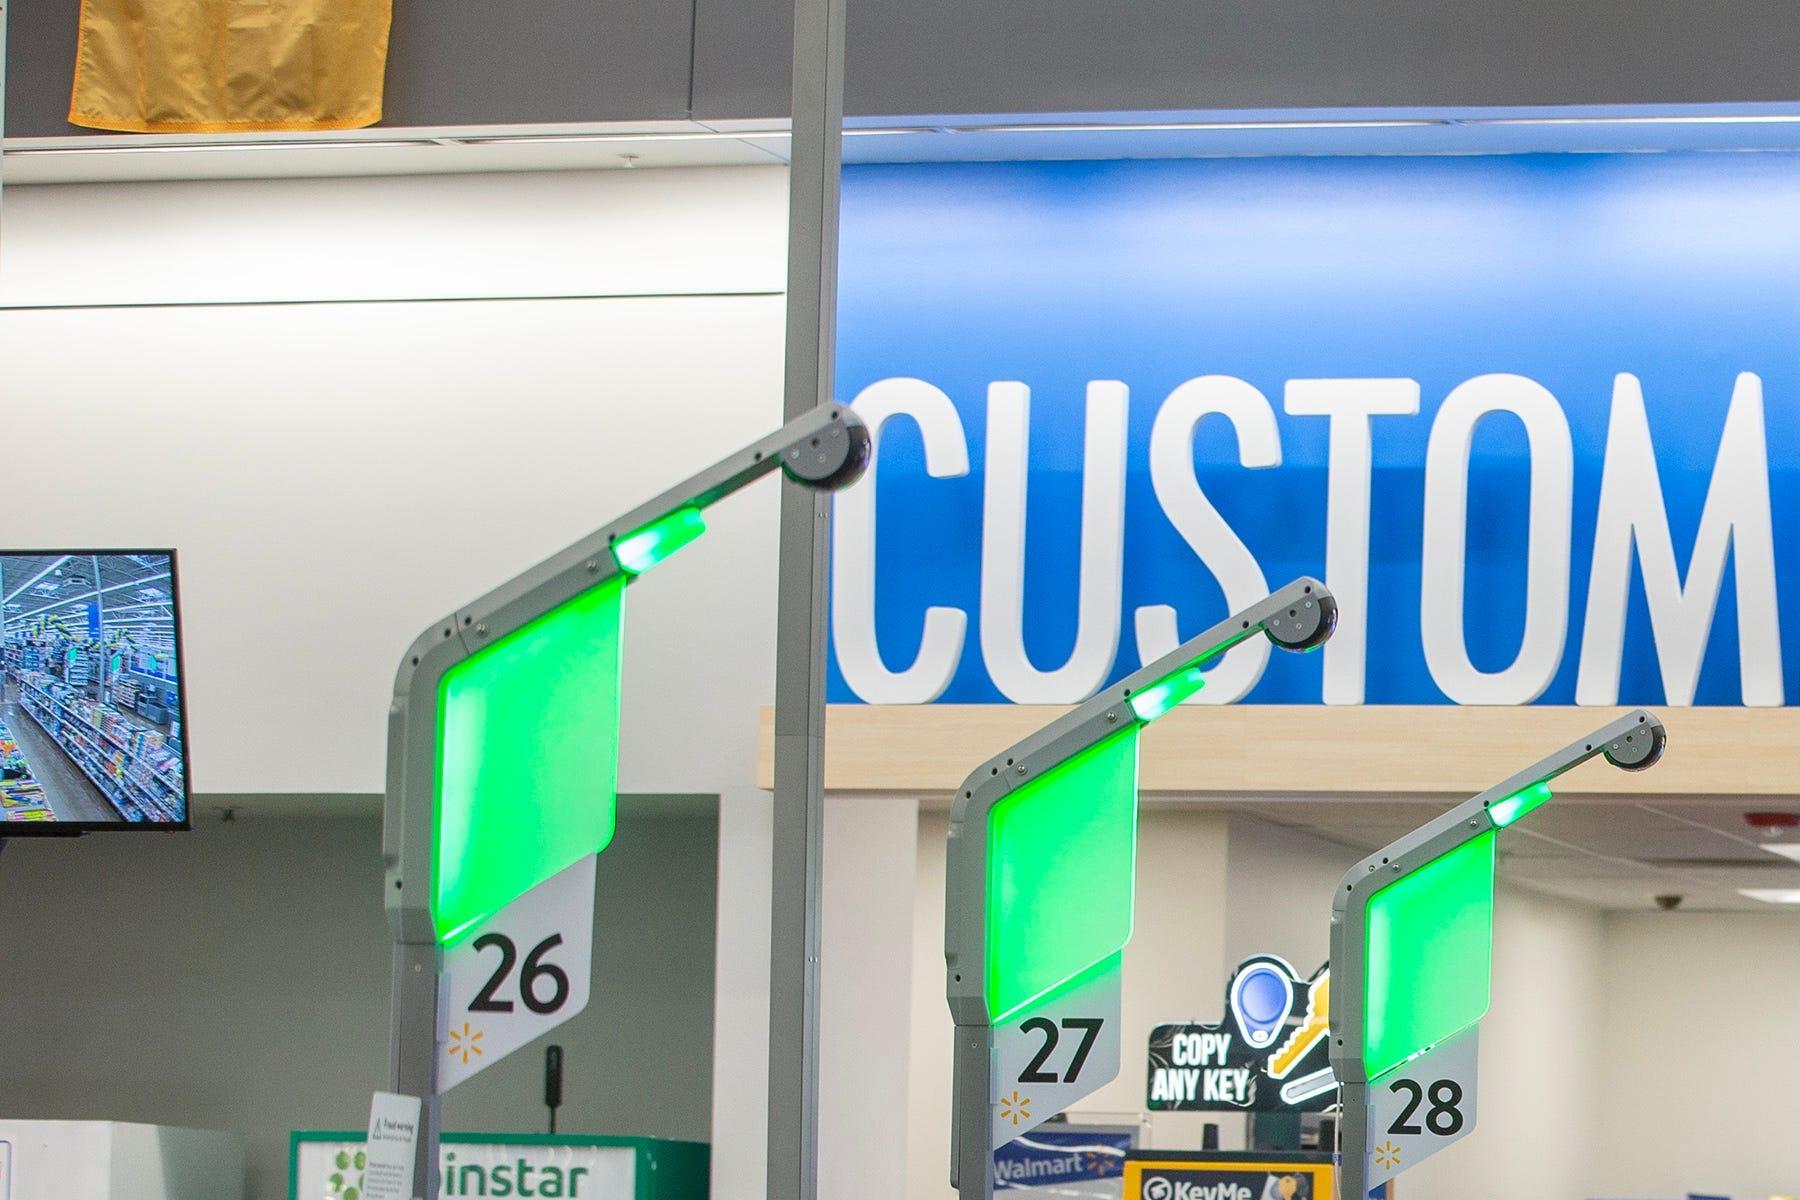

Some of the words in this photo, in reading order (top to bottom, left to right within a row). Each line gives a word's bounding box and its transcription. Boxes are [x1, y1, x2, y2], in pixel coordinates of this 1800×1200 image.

[468, 933, 569, 1015] 26
[1018, 1017, 1105, 1083] 27
[1172, 1033, 1232, 1066] COPY
[1151, 1068, 1200, 1101] ANY
[1203, 1068, 1250, 1101] KEY
[1386, 1078, 1464, 1136] 28
[436, 1150, 590, 1199] instar
[994, 1152, 1084, 1180] Walmart
